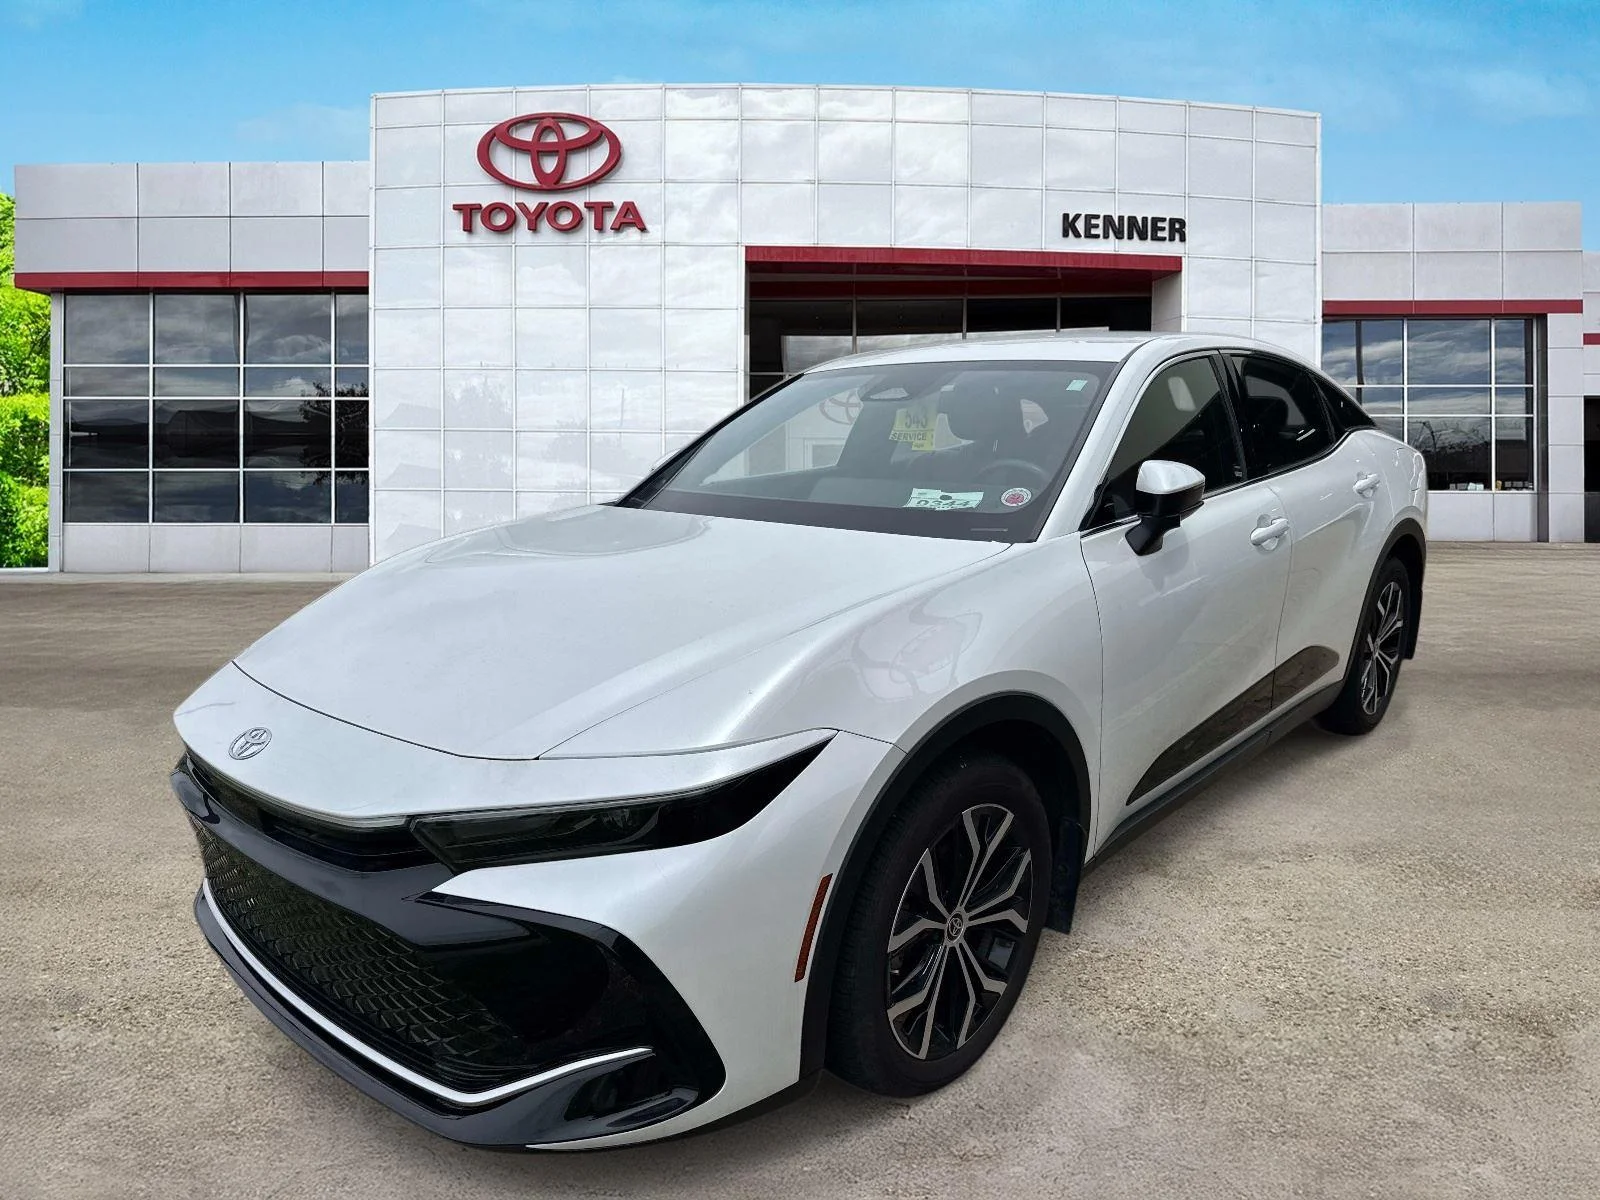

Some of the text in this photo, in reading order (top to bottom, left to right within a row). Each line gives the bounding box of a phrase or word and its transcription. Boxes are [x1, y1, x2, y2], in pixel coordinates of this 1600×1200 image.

[452, 201, 647, 232] TOYOTA
[1062, 213, 1187, 242] KENNER
[890, 431, 927, 441] SERVICE
